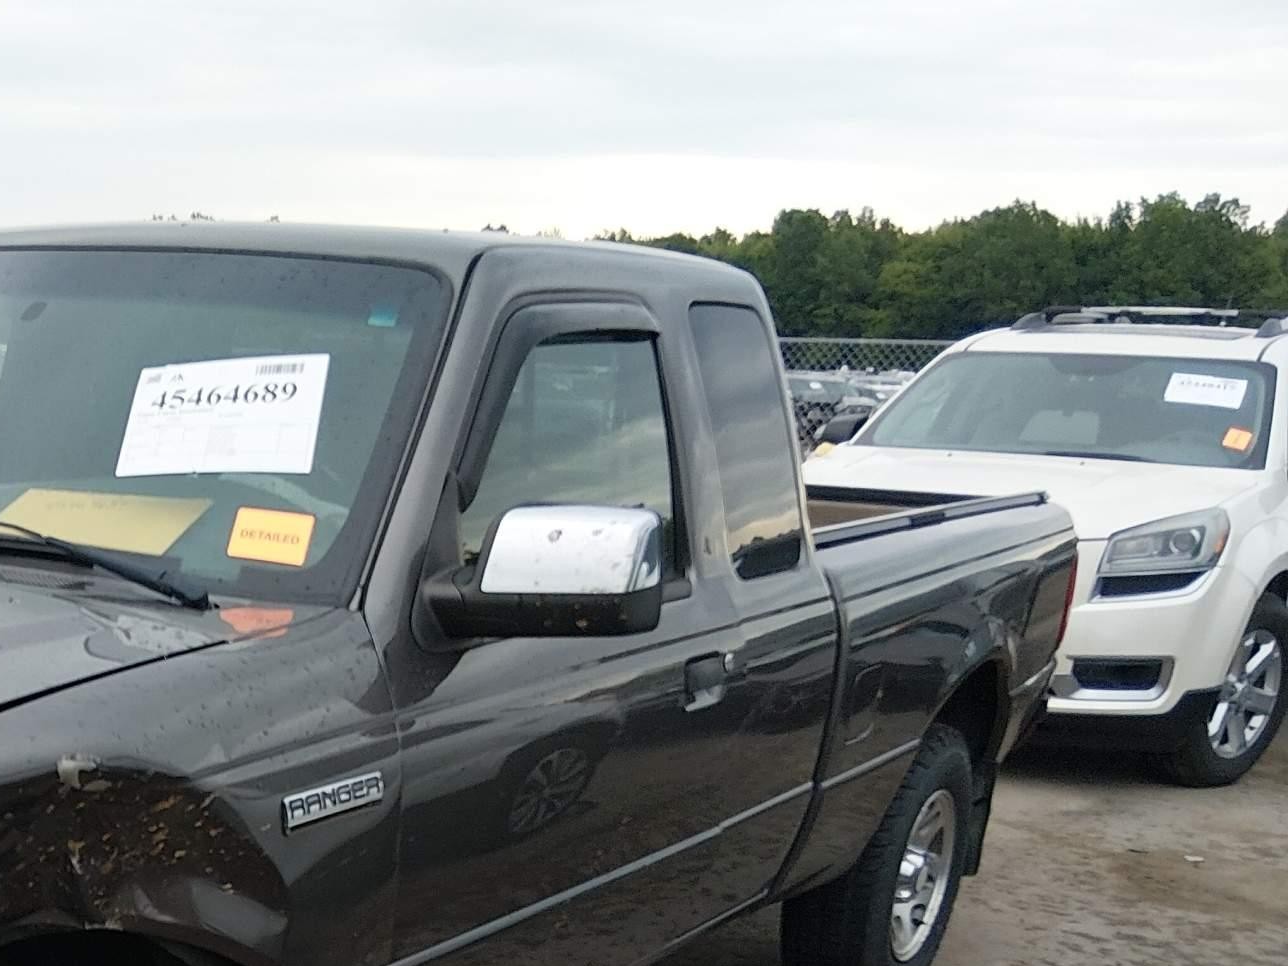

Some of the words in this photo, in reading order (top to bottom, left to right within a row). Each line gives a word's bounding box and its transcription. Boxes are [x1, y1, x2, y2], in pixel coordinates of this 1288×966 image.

[151, 381, 298, 409] 45464689
[240, 528, 301, 545] DETAILED
[289, 775, 381, 820] RANGER
